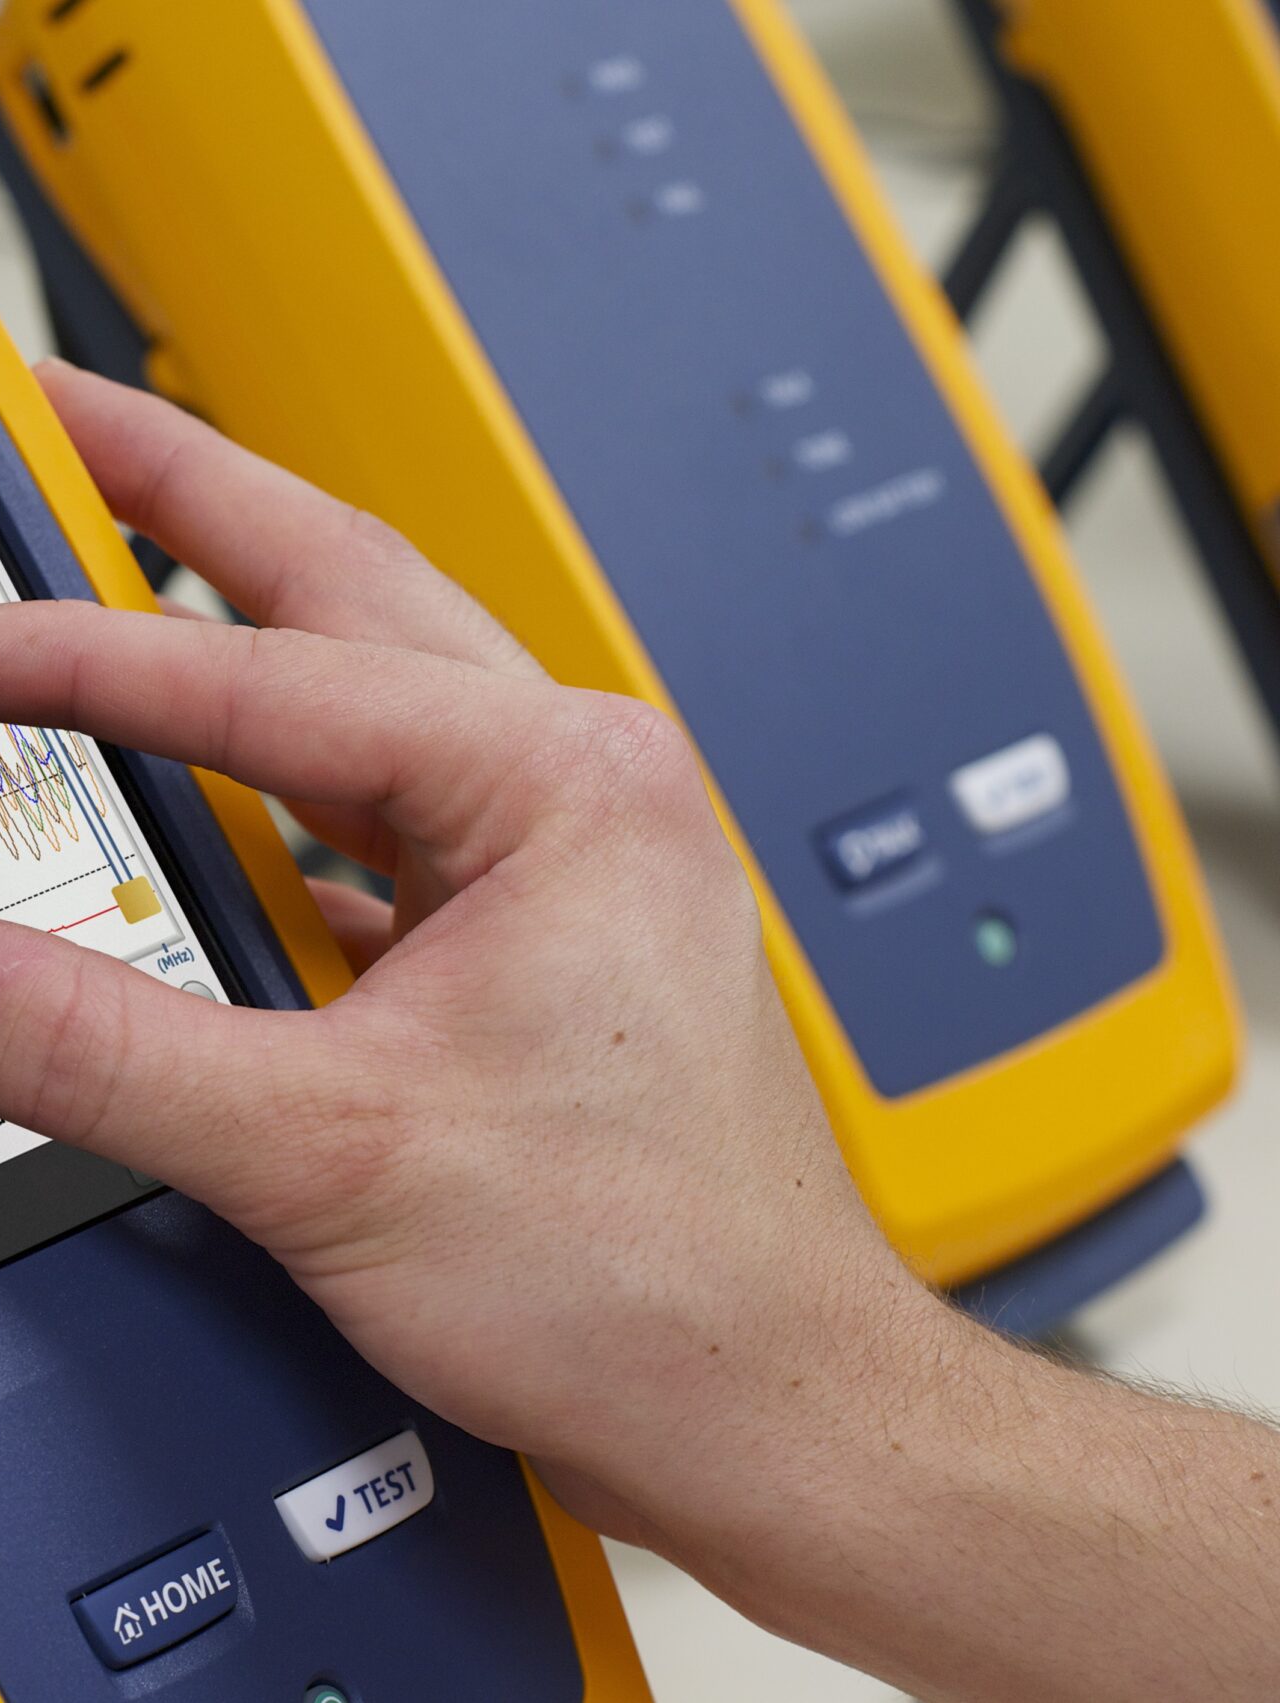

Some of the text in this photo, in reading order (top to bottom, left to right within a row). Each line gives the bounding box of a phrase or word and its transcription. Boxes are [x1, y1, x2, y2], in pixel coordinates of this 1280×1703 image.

[157, 946, 195, 974] (MHz)
[353, 1461, 417, 1515] TEST
[139, 1558, 232, 1627] HOME
